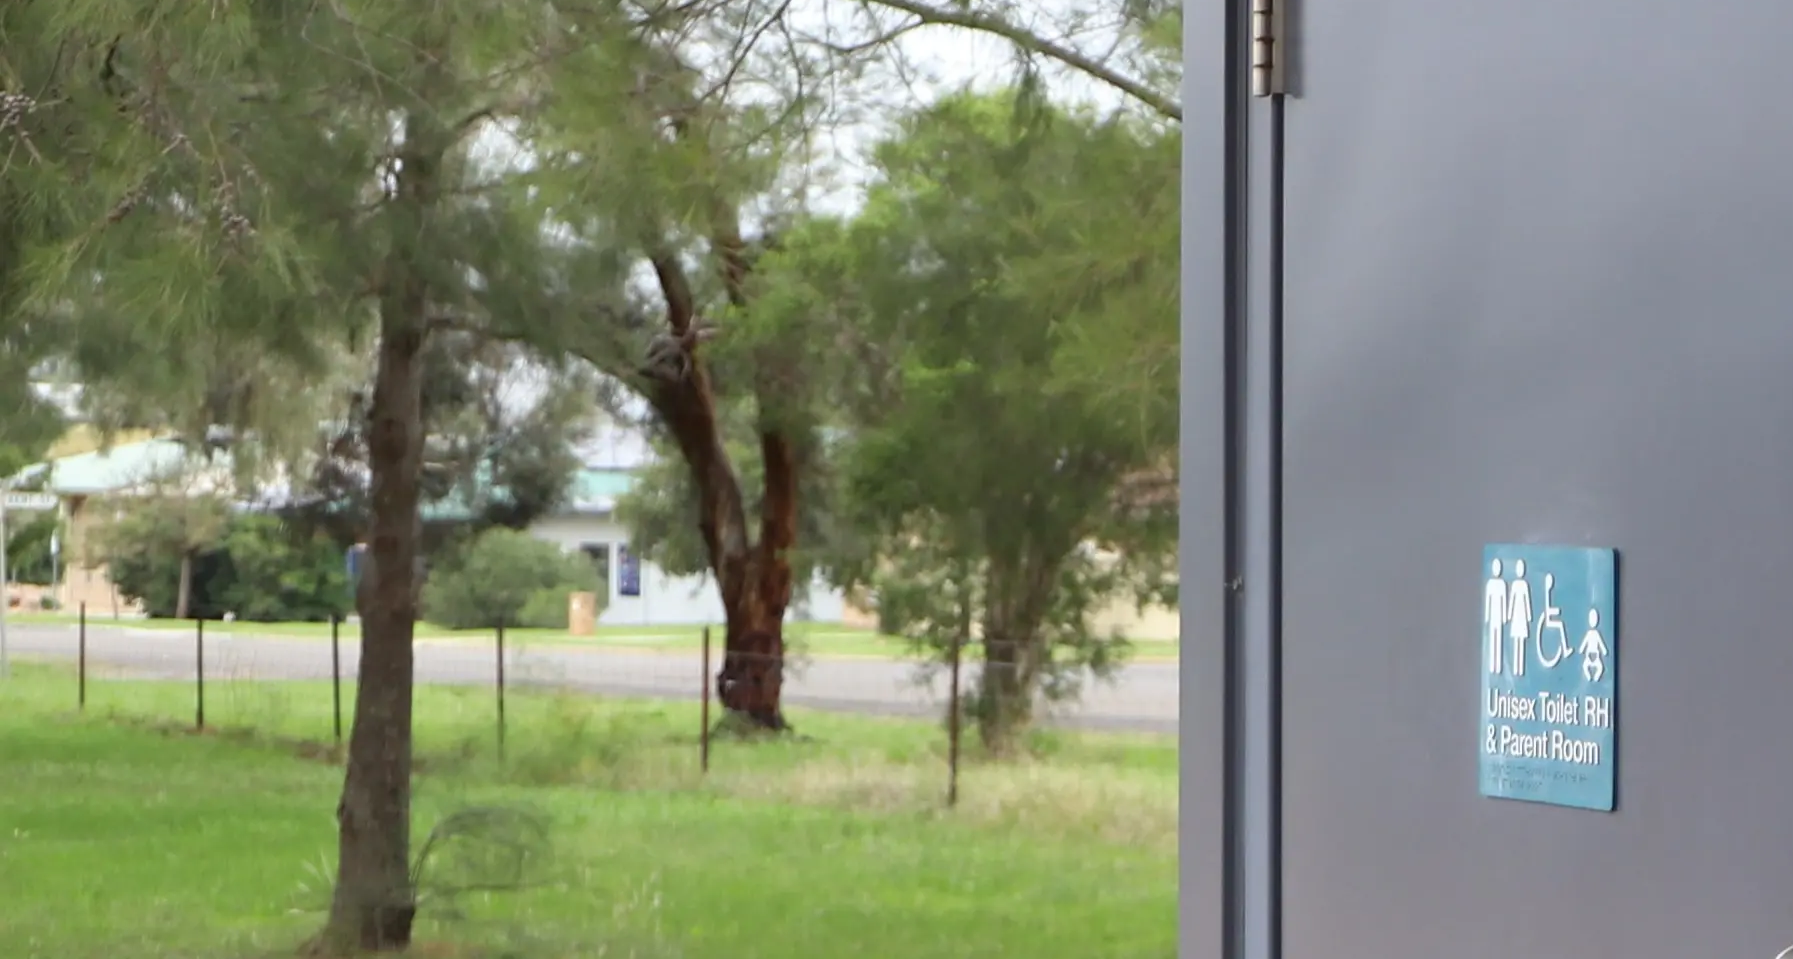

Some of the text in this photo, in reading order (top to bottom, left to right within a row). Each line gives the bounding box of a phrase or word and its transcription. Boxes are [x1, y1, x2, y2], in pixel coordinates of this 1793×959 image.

[1487, 688, 1610, 728] Unisex Toilet RH
[1486, 726, 1600, 764] & Parent Room
